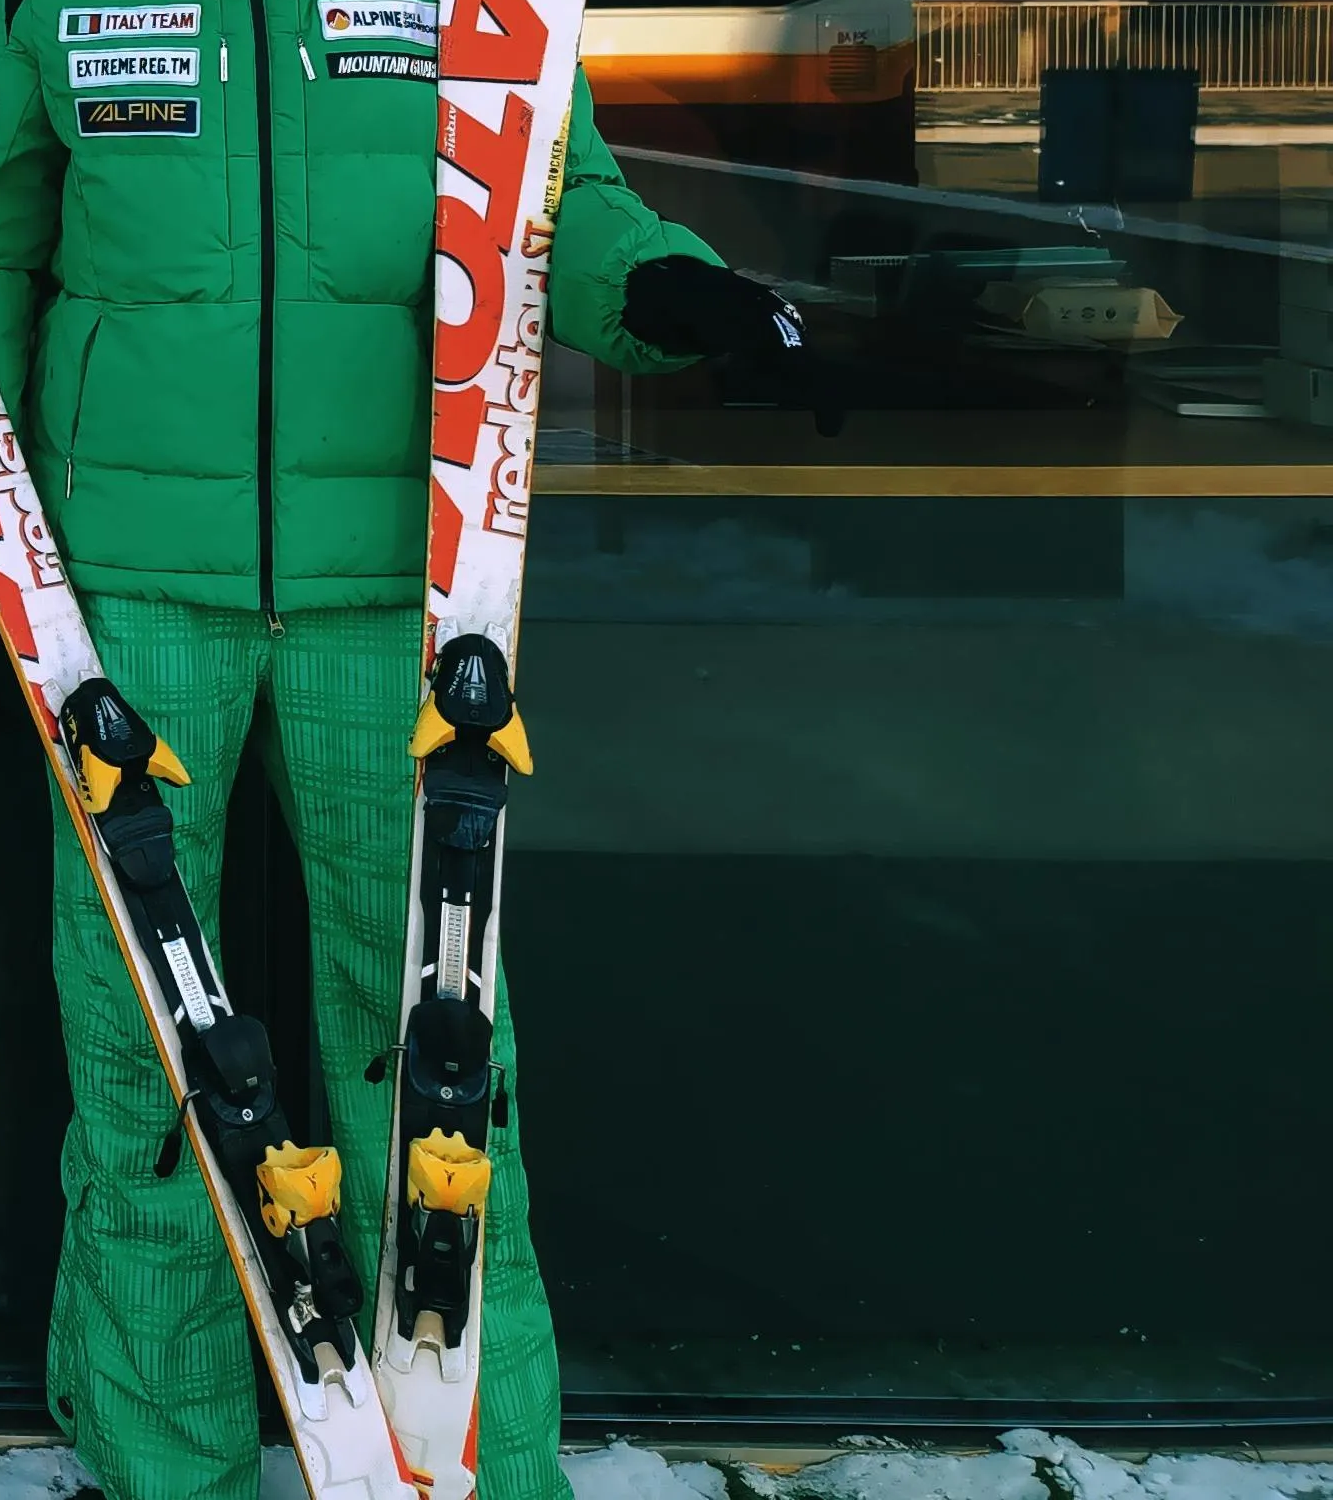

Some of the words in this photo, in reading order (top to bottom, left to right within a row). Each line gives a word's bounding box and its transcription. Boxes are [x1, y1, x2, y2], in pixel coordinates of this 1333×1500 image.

[105, 12, 147, 31] ITALY
[151, 11, 195, 29] TEAM
[352, 10, 403, 29] ALPINE
[76, 57, 137, 78] EXTREME
[138, 57, 191, 76] REG.TM
[337, 55, 410, 74] MOUNTAIN
